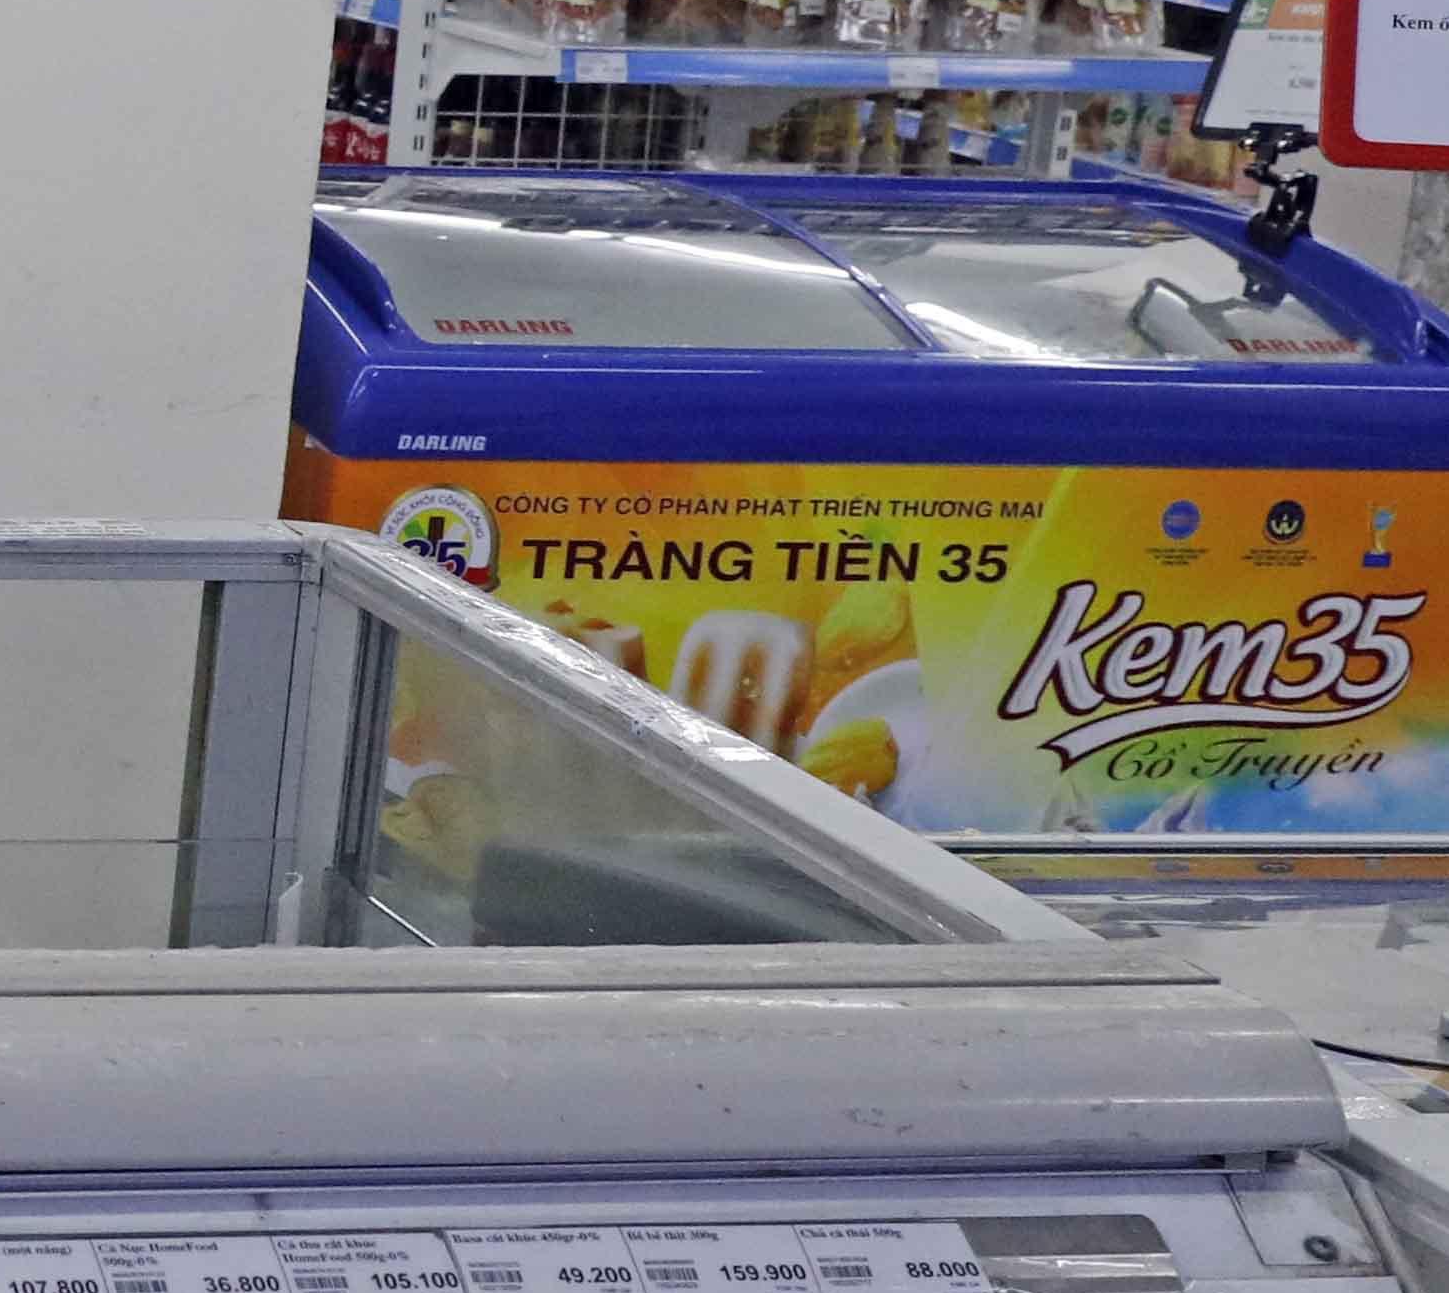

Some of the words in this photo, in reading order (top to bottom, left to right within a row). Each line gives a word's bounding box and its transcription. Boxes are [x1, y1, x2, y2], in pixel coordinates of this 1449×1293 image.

[1391, 13, 1435, 31] Kem
[396, 433, 488, 453] DARLING
[495, 495, 569, 515] CÔNG
[578, 497, 608, 515] TY
[521, 529, 753, 583] TRÀNG
[774, 528, 922, 583] TIỀN
[937, 542, 1009, 584] 35
[999, 580, 1430, 721] Kem35
[1198, 735, 1390, 793] Truyền
[558, 1266, 633, 1284] 49.200
[719, 1264, 807, 1282] 159.900
[905, 1262, 980, 1279] 88.000
[203, 1276, 280, 1293] 36.800
[371, 1272, 458, 1291] 105.100
